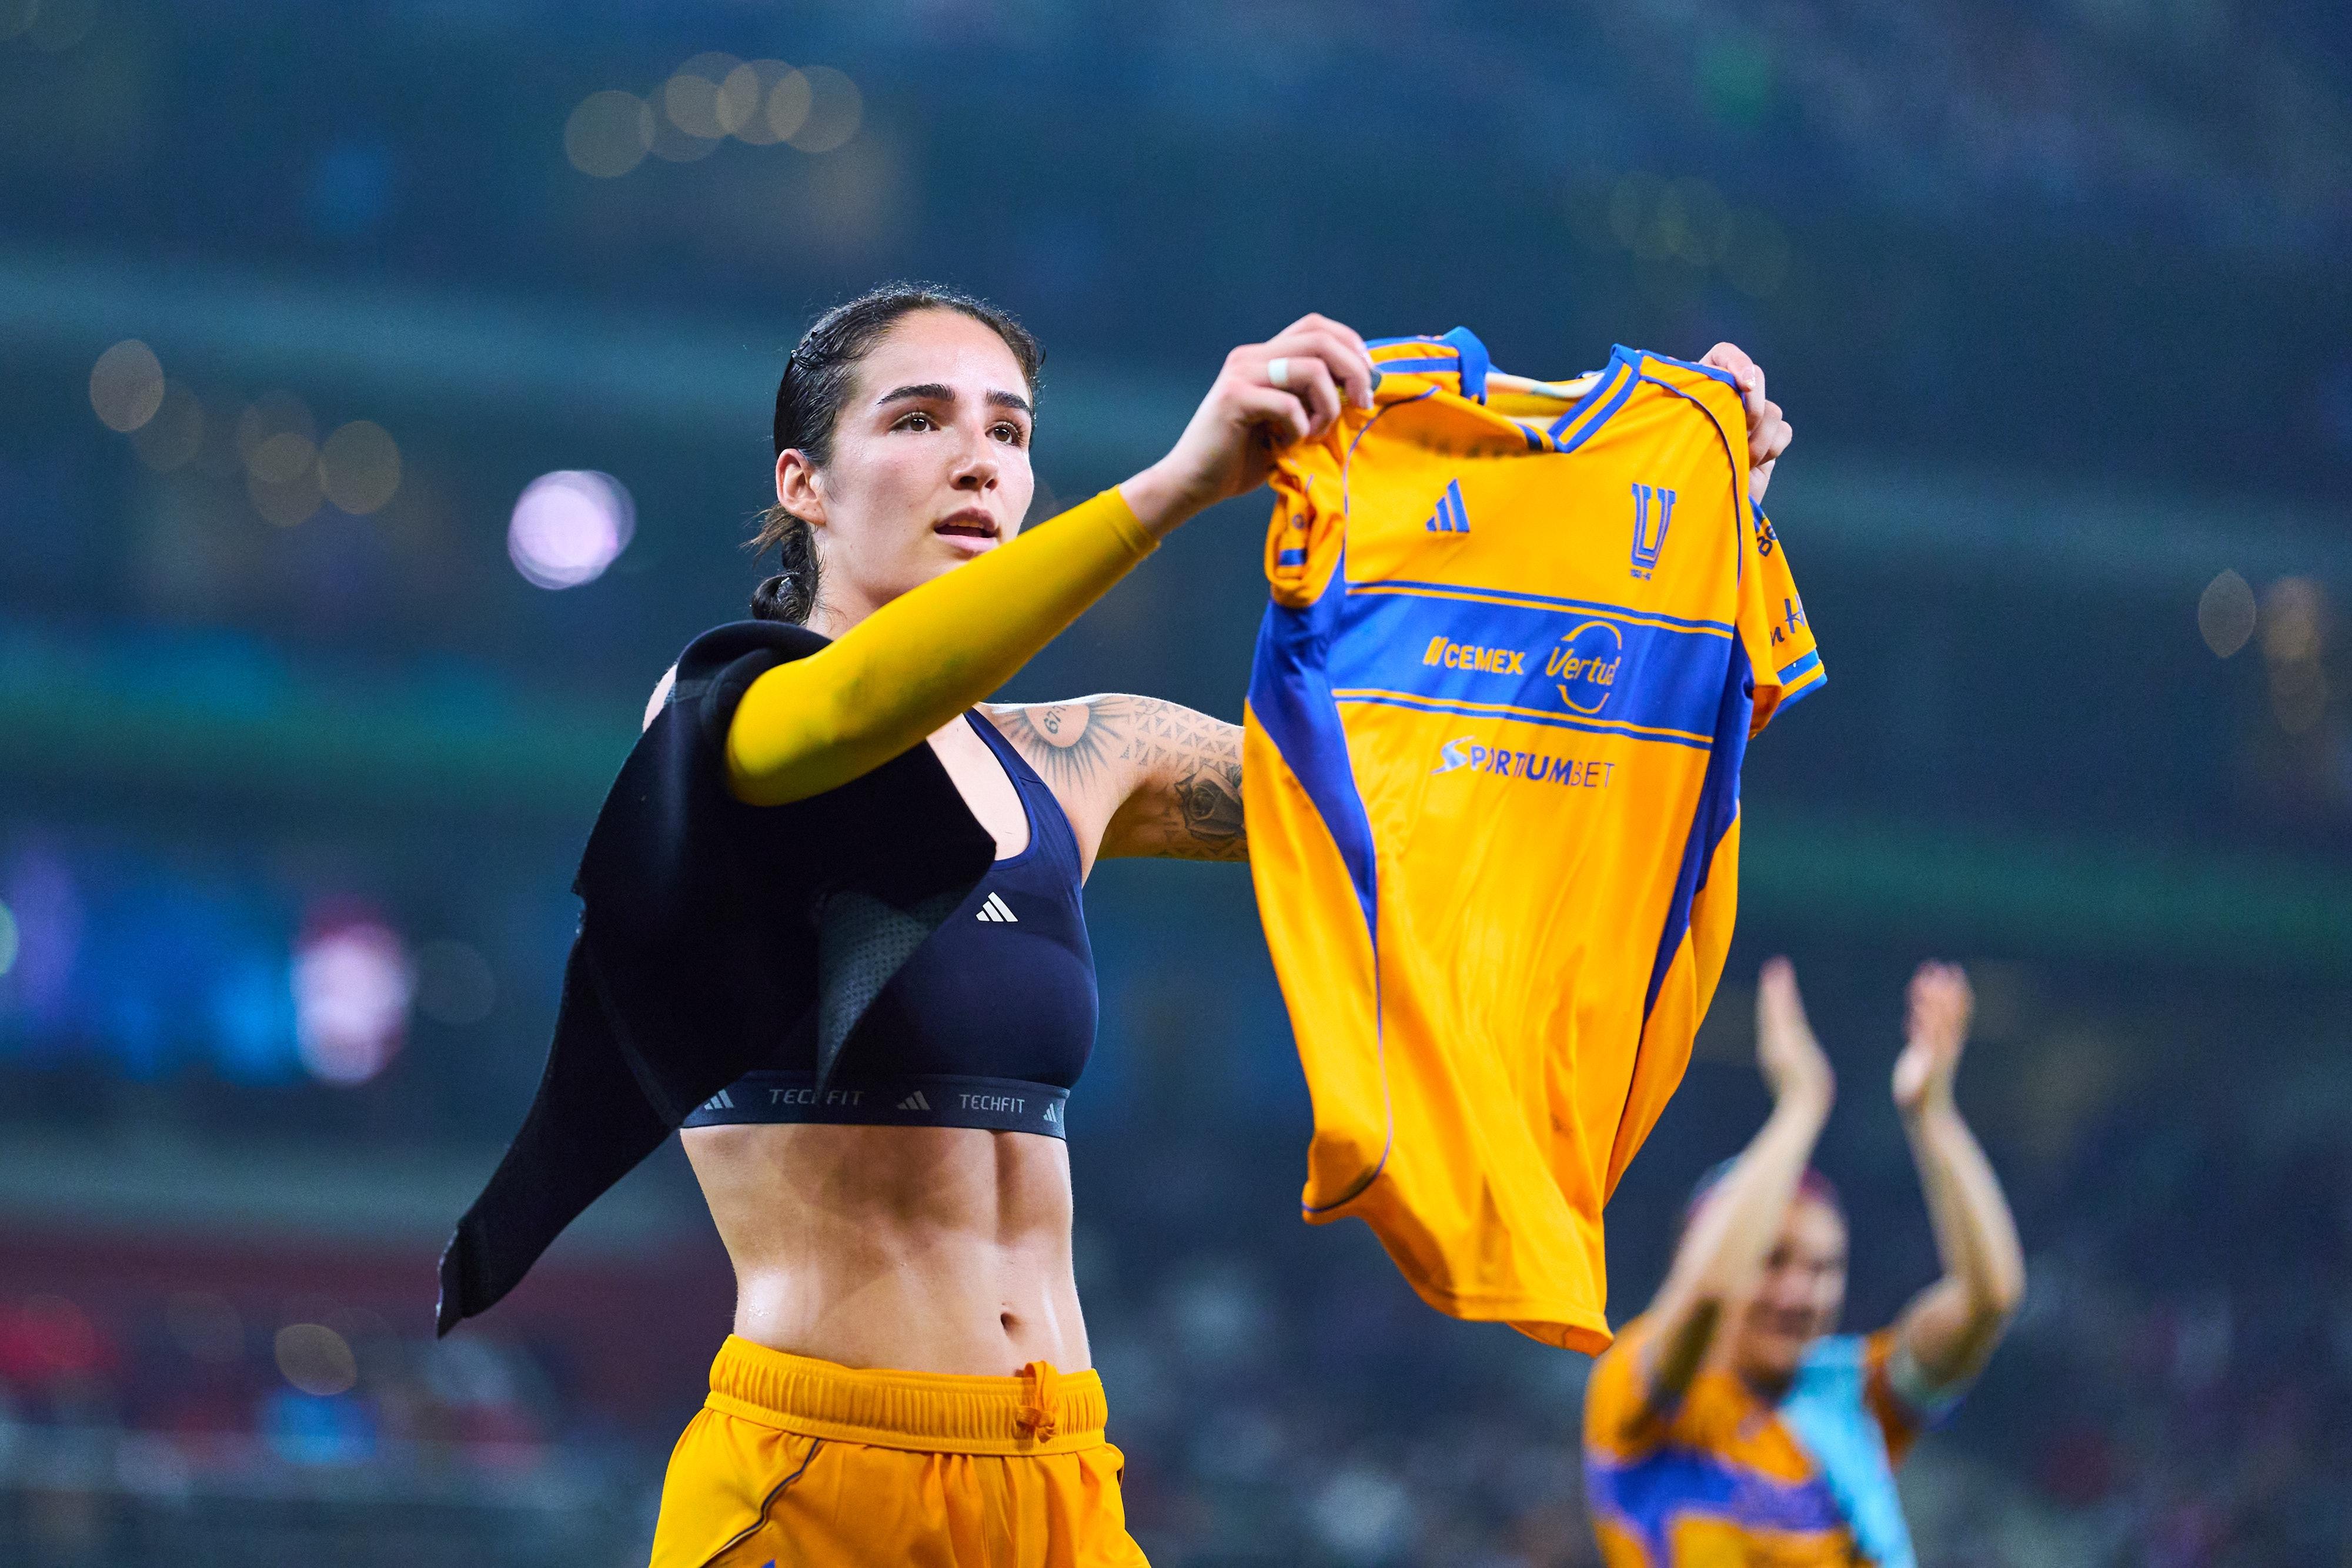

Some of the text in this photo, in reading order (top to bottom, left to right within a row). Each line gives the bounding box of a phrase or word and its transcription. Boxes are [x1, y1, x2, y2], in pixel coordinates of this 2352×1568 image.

[1444, 643, 1525, 675] CEMEX
[769, 1089, 1025, 1113] TECFIT TECHFIT
